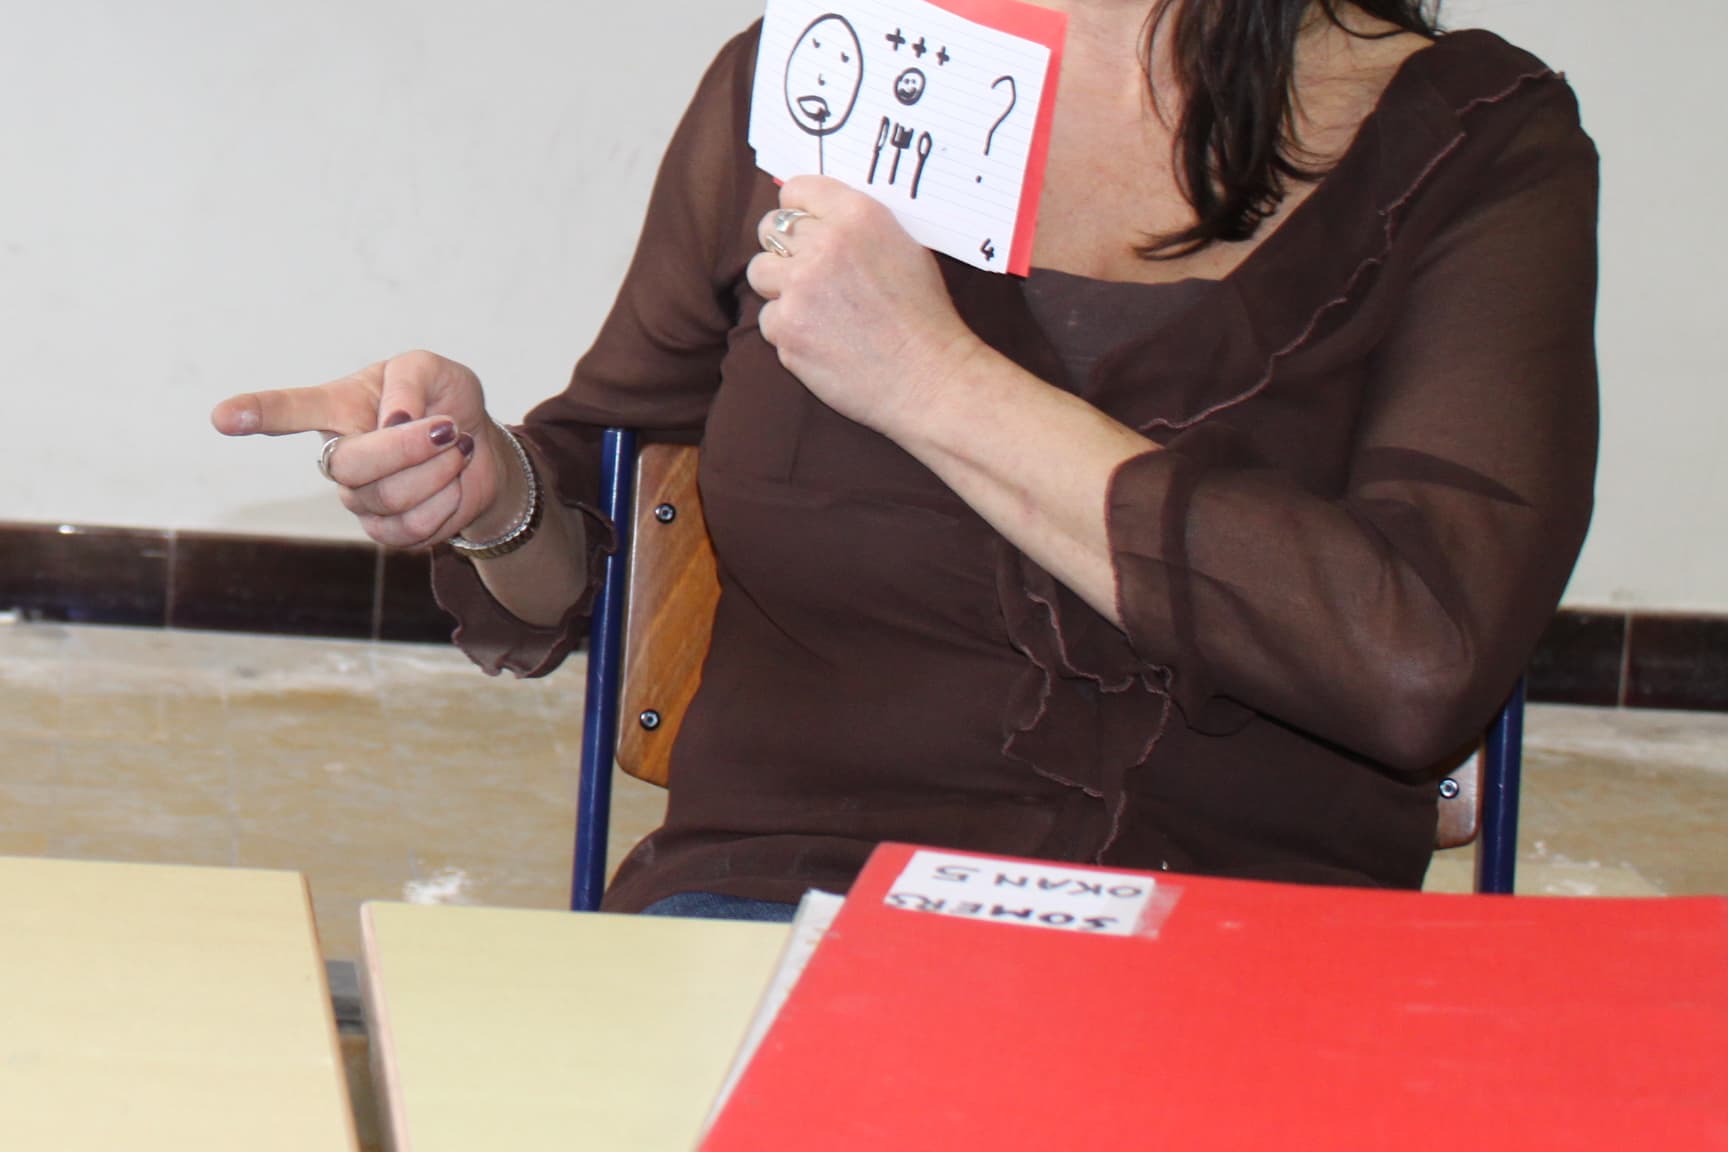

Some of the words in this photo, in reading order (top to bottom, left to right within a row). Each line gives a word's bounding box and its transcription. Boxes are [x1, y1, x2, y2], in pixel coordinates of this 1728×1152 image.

[980, 238, 995, 261] 4
[932, 864, 980, 883] 5
[993, 871, 1144, 899] OKAN
[889, 892, 1119, 931] SOMERS
